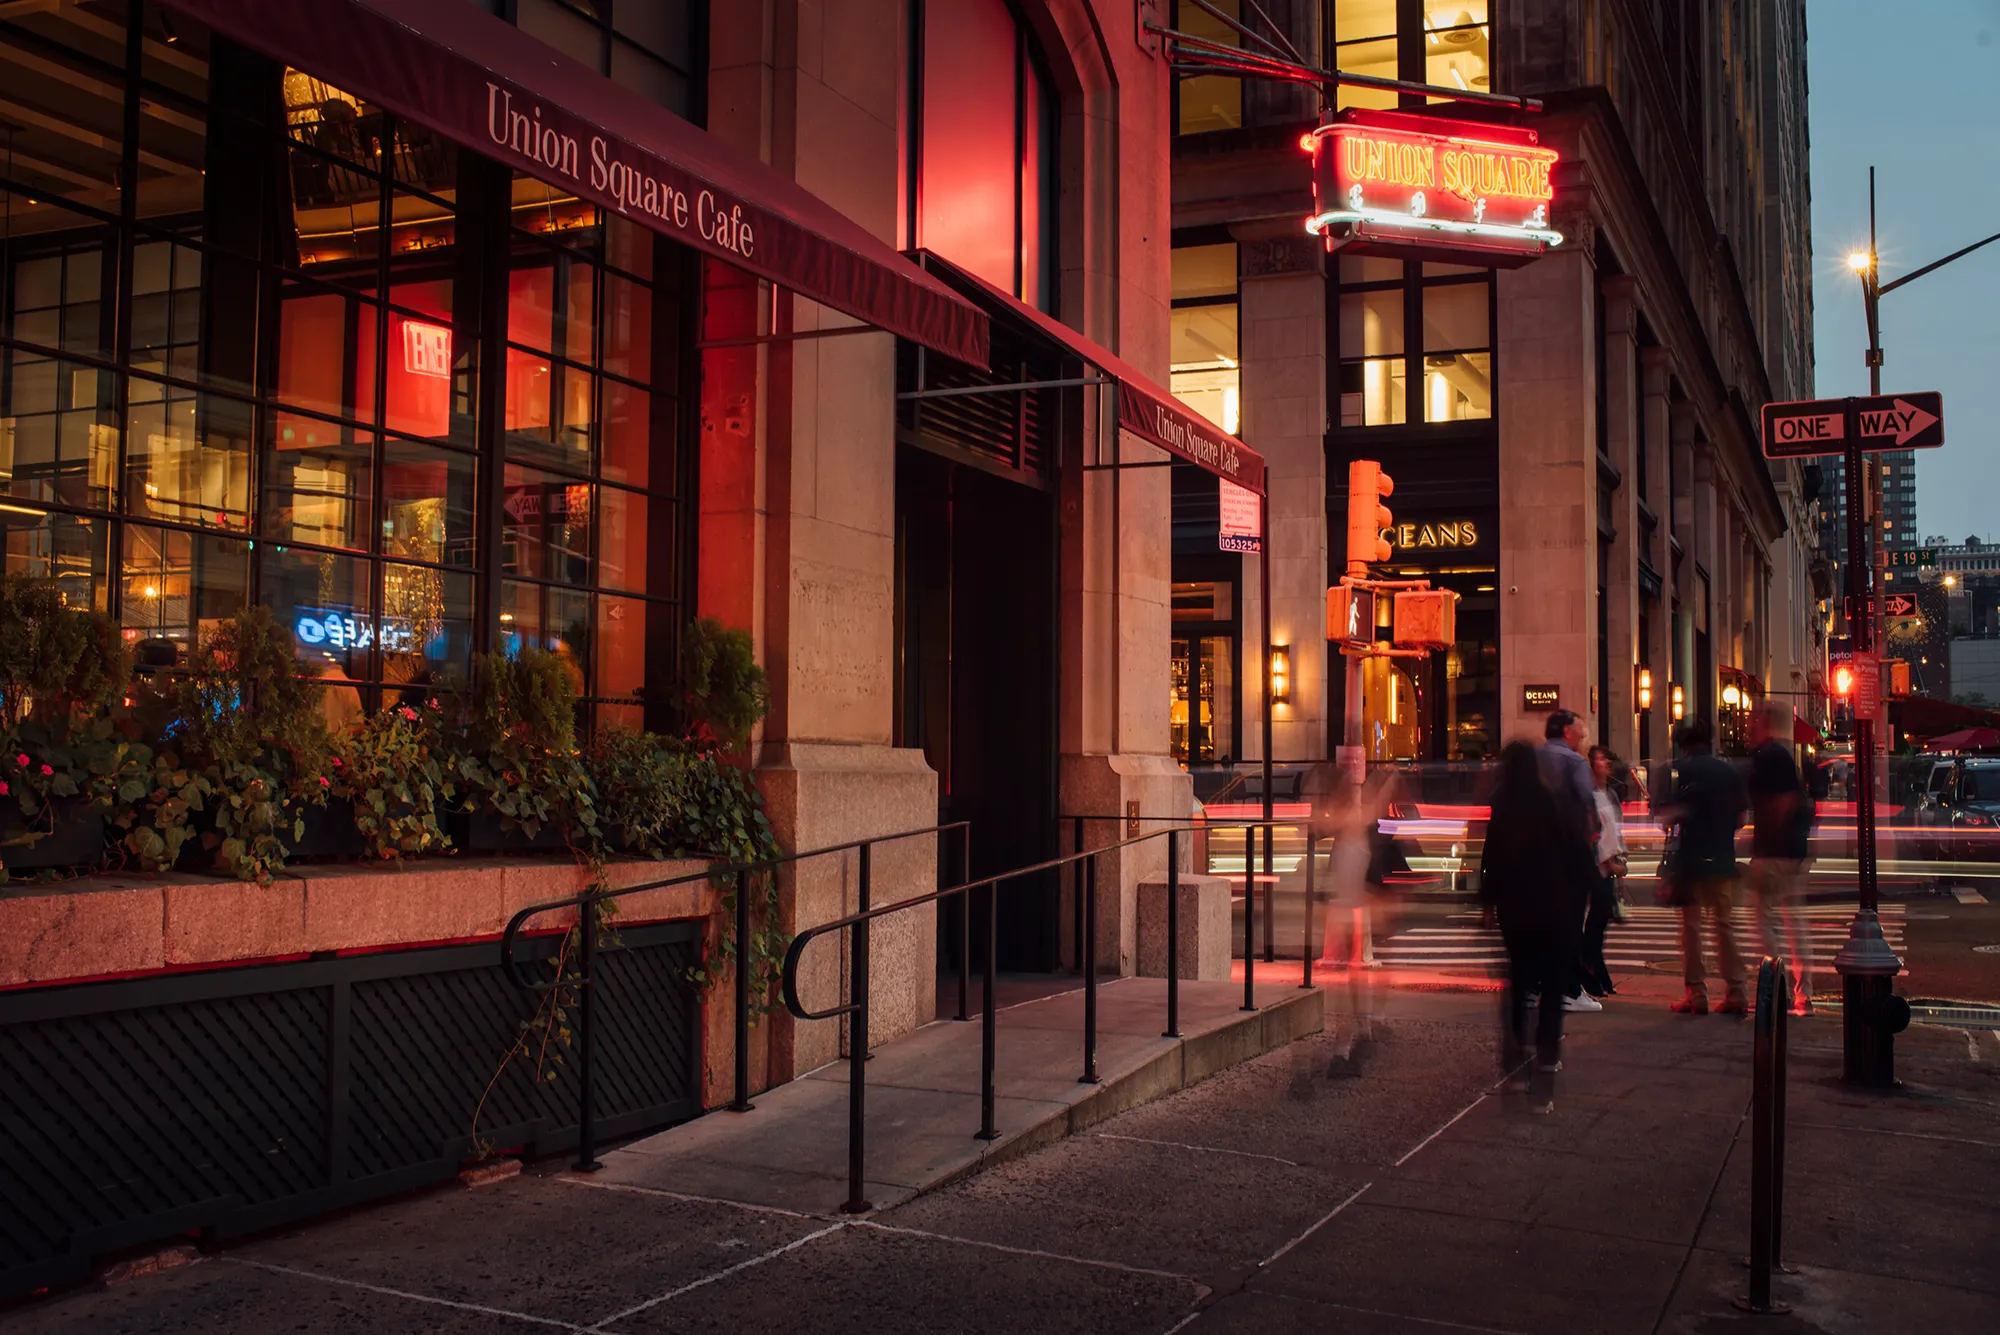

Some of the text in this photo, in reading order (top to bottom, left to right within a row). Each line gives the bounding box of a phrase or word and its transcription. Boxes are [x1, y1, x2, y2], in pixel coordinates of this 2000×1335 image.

[486, 82, 754, 257] Union Square Cafe
[1345, 137, 1553, 202] UNION SQUARE
[1780, 411, 1916, 440] ONE WAY
[1156, 405, 1240, 476] Union Square Cafe
[1379, 521, 1477, 548] CEANS
[1892, 552, 1930, 565] E 19 St
[1525, 691, 1558, 700] OCEANS
